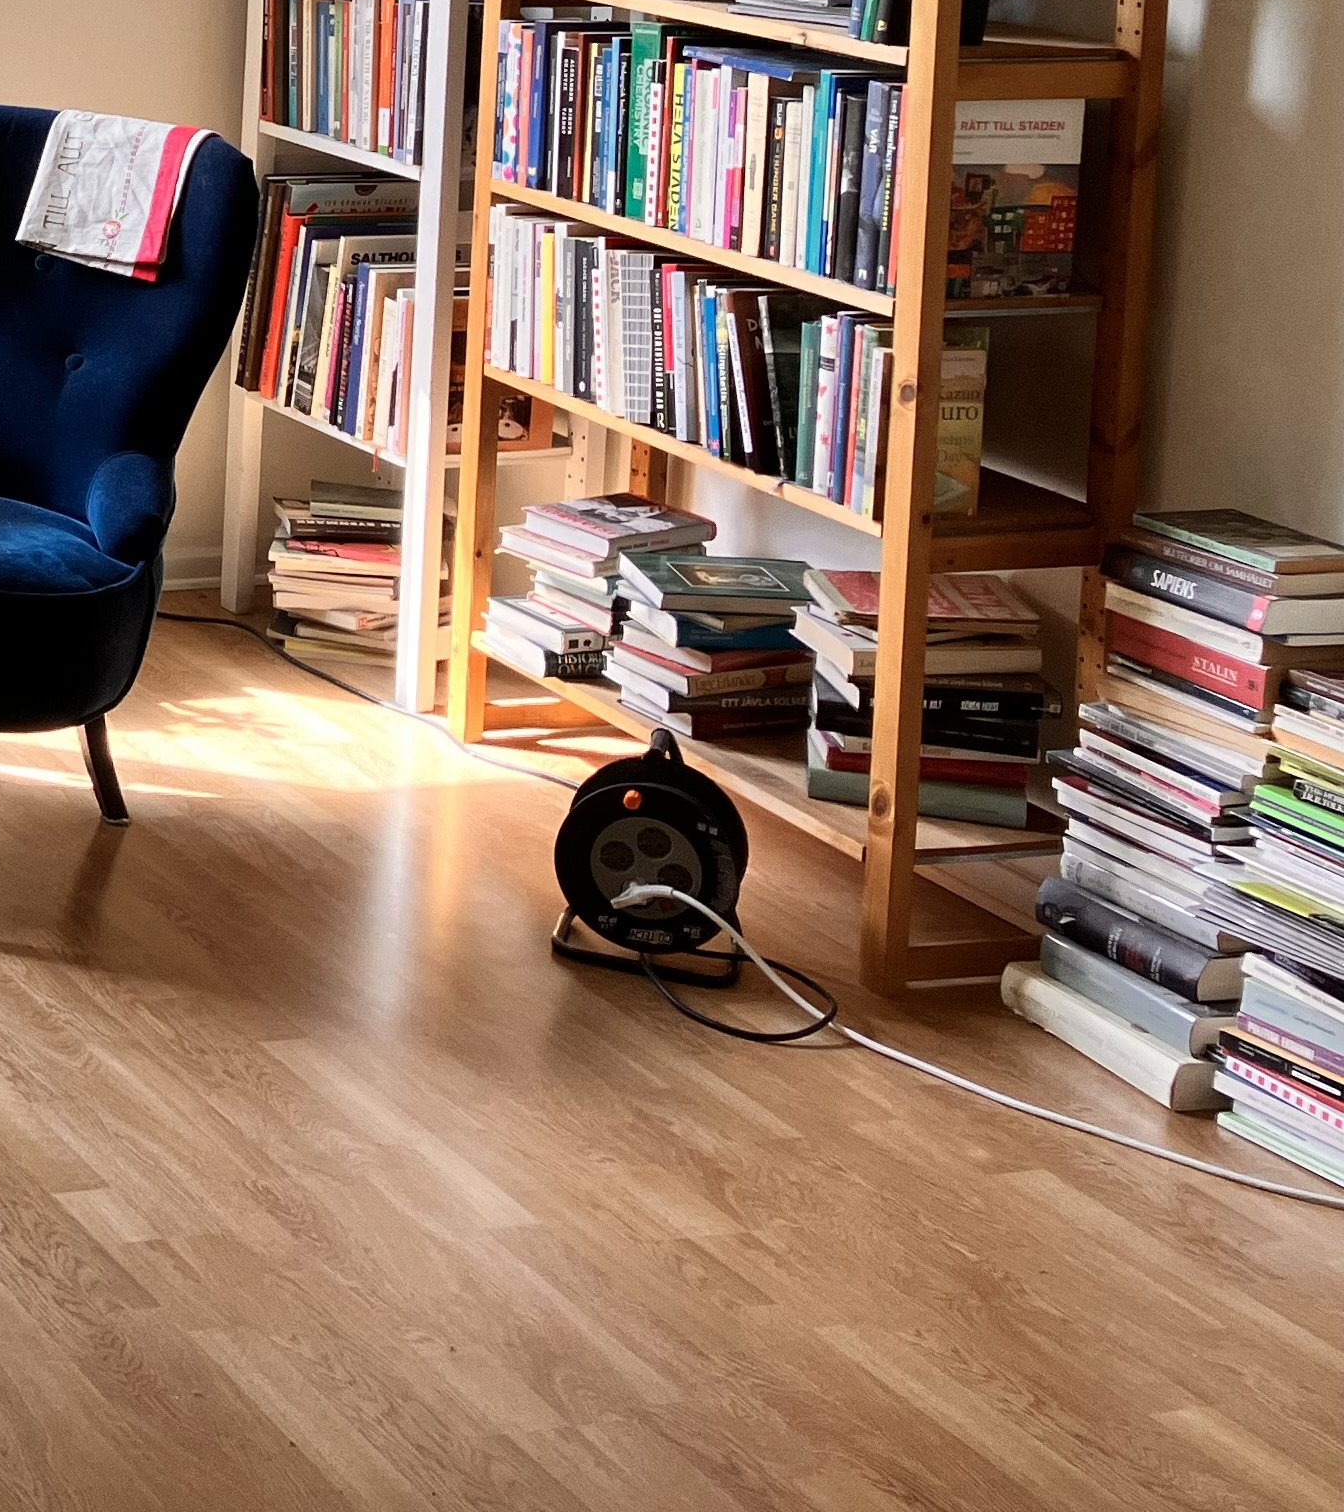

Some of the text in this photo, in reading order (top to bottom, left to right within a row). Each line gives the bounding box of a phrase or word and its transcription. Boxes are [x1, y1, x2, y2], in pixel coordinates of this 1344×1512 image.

[632, 64, 646, 148] CHEMISTRY
[961, 119, 1065, 131] RÄTT TILL STADEN
[1150, 569, 1198, 600] SAPIENS
[1192, 656, 1238, 682] STALIN
